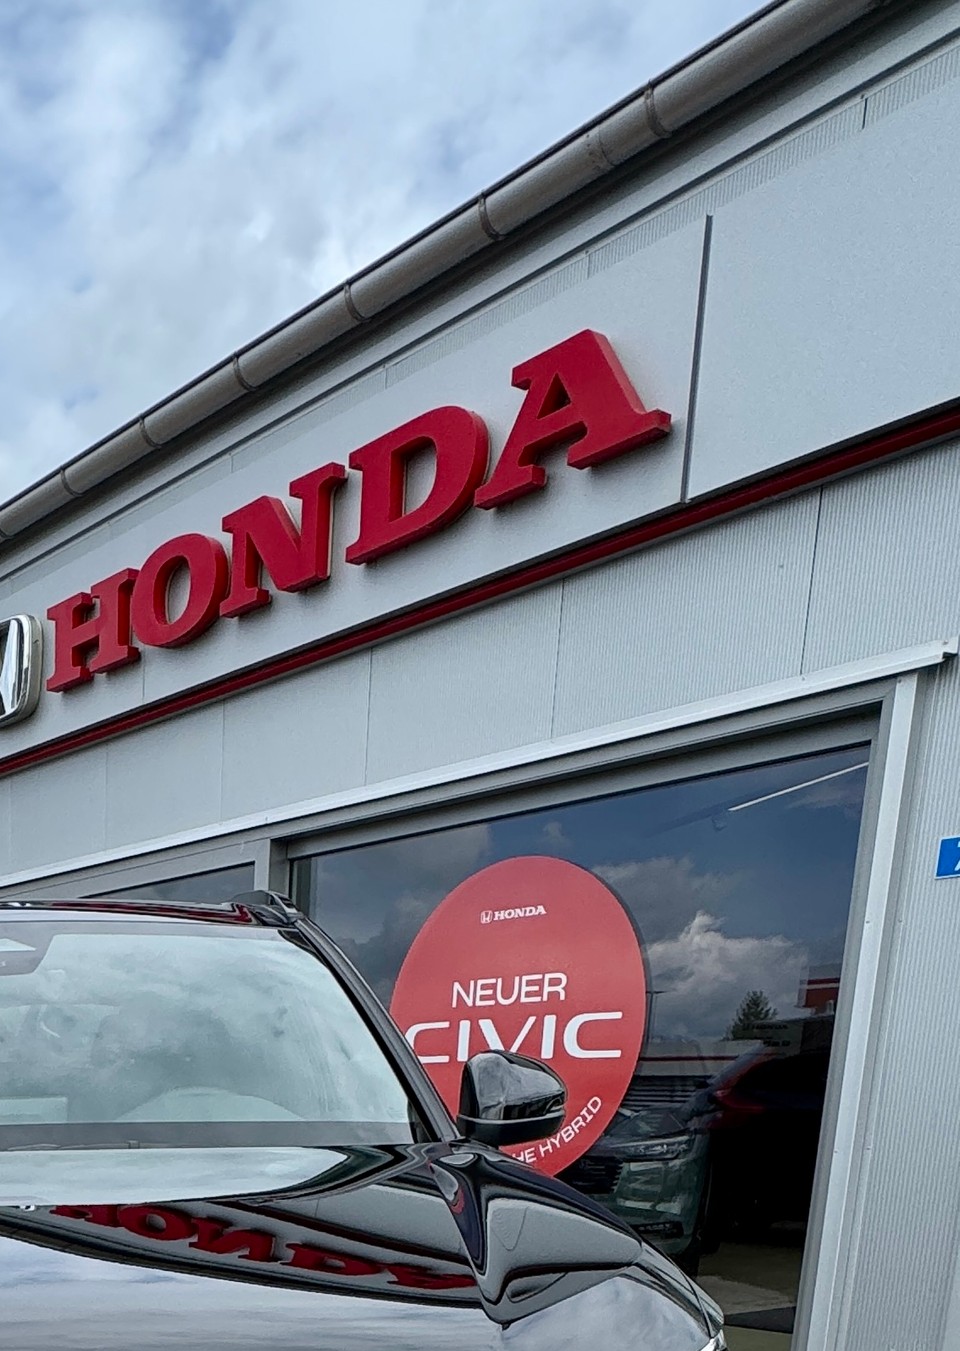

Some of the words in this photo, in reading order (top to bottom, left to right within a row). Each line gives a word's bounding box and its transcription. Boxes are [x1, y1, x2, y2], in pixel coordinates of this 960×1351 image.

[47, 329, 671, 693] HONDA
[493, 905, 547, 921] HONDA
[451, 972, 568, 1008] NEUER
[404, 1011, 623, 1064] CIVIC
[539, 1095, 602, 1158] HYBRID
